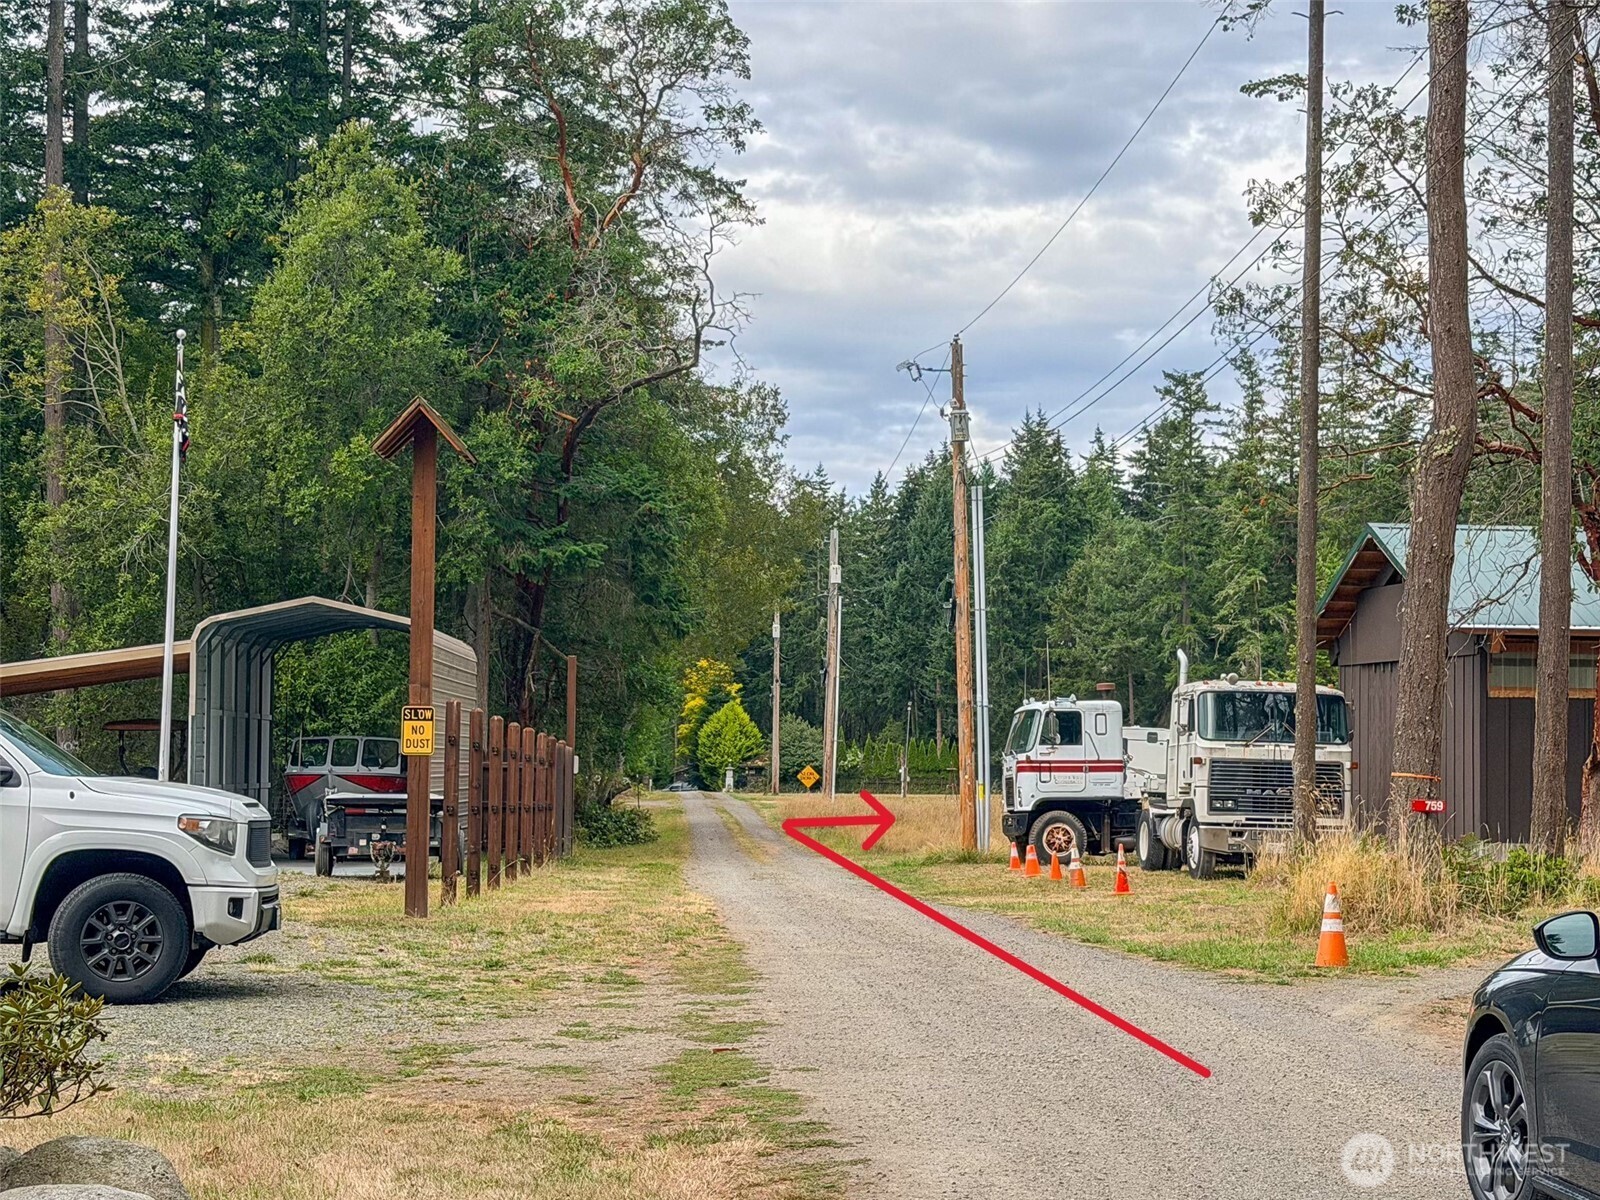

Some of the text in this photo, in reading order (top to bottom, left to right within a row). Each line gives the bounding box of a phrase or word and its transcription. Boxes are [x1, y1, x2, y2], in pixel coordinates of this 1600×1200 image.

[404, 709, 432, 720] SLOW
[411, 725, 425, 735] NO
[406, 738, 430, 749] DUST
[1425, 800, 1443, 811] 759
